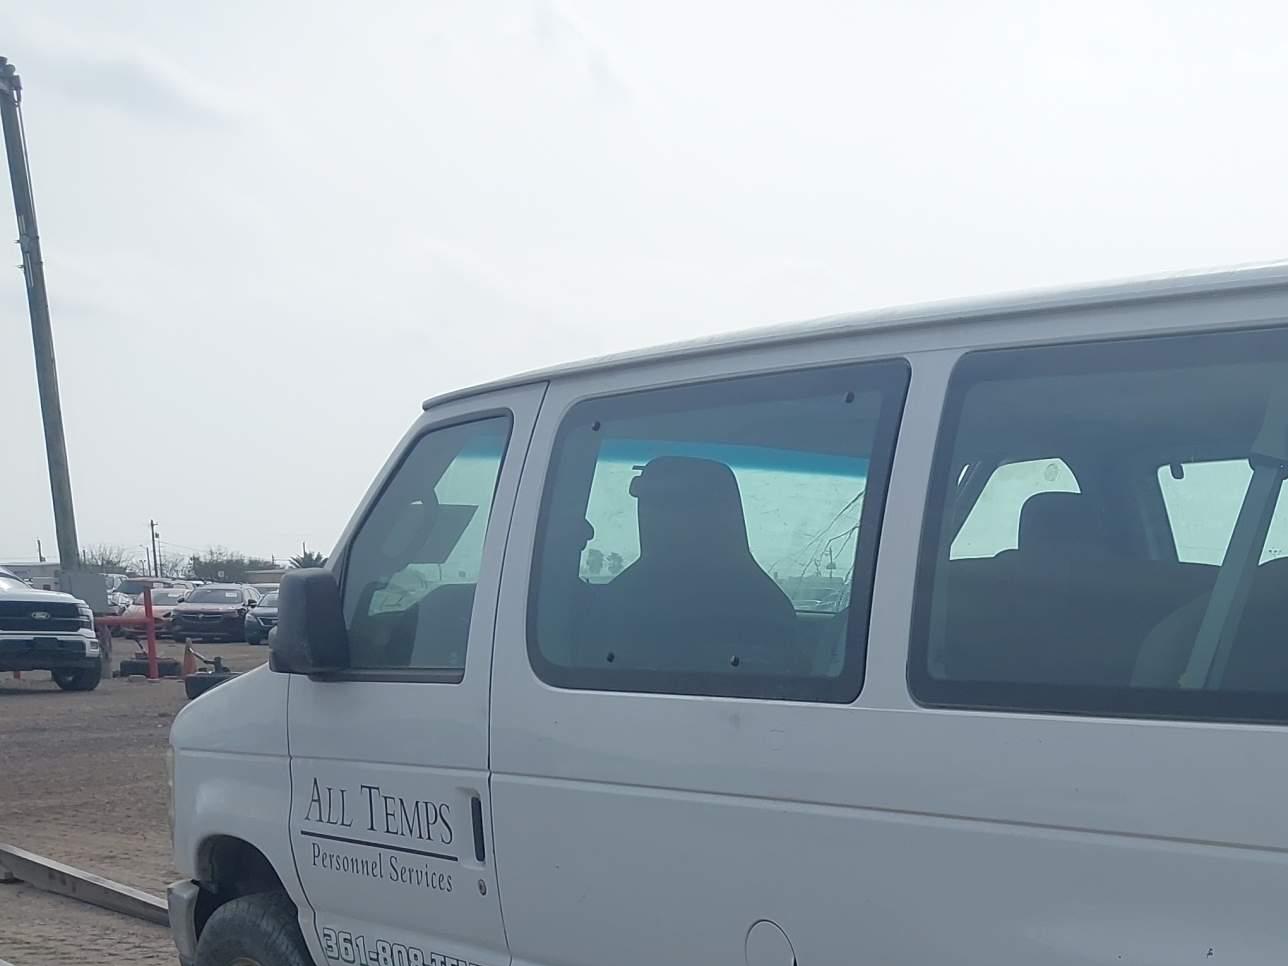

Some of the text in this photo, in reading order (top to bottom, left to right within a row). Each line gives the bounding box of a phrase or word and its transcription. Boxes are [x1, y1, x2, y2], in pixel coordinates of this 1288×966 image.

[304, 777, 453, 845] ALL TEMPS
[312, 842, 452, 892] Personnel Services
